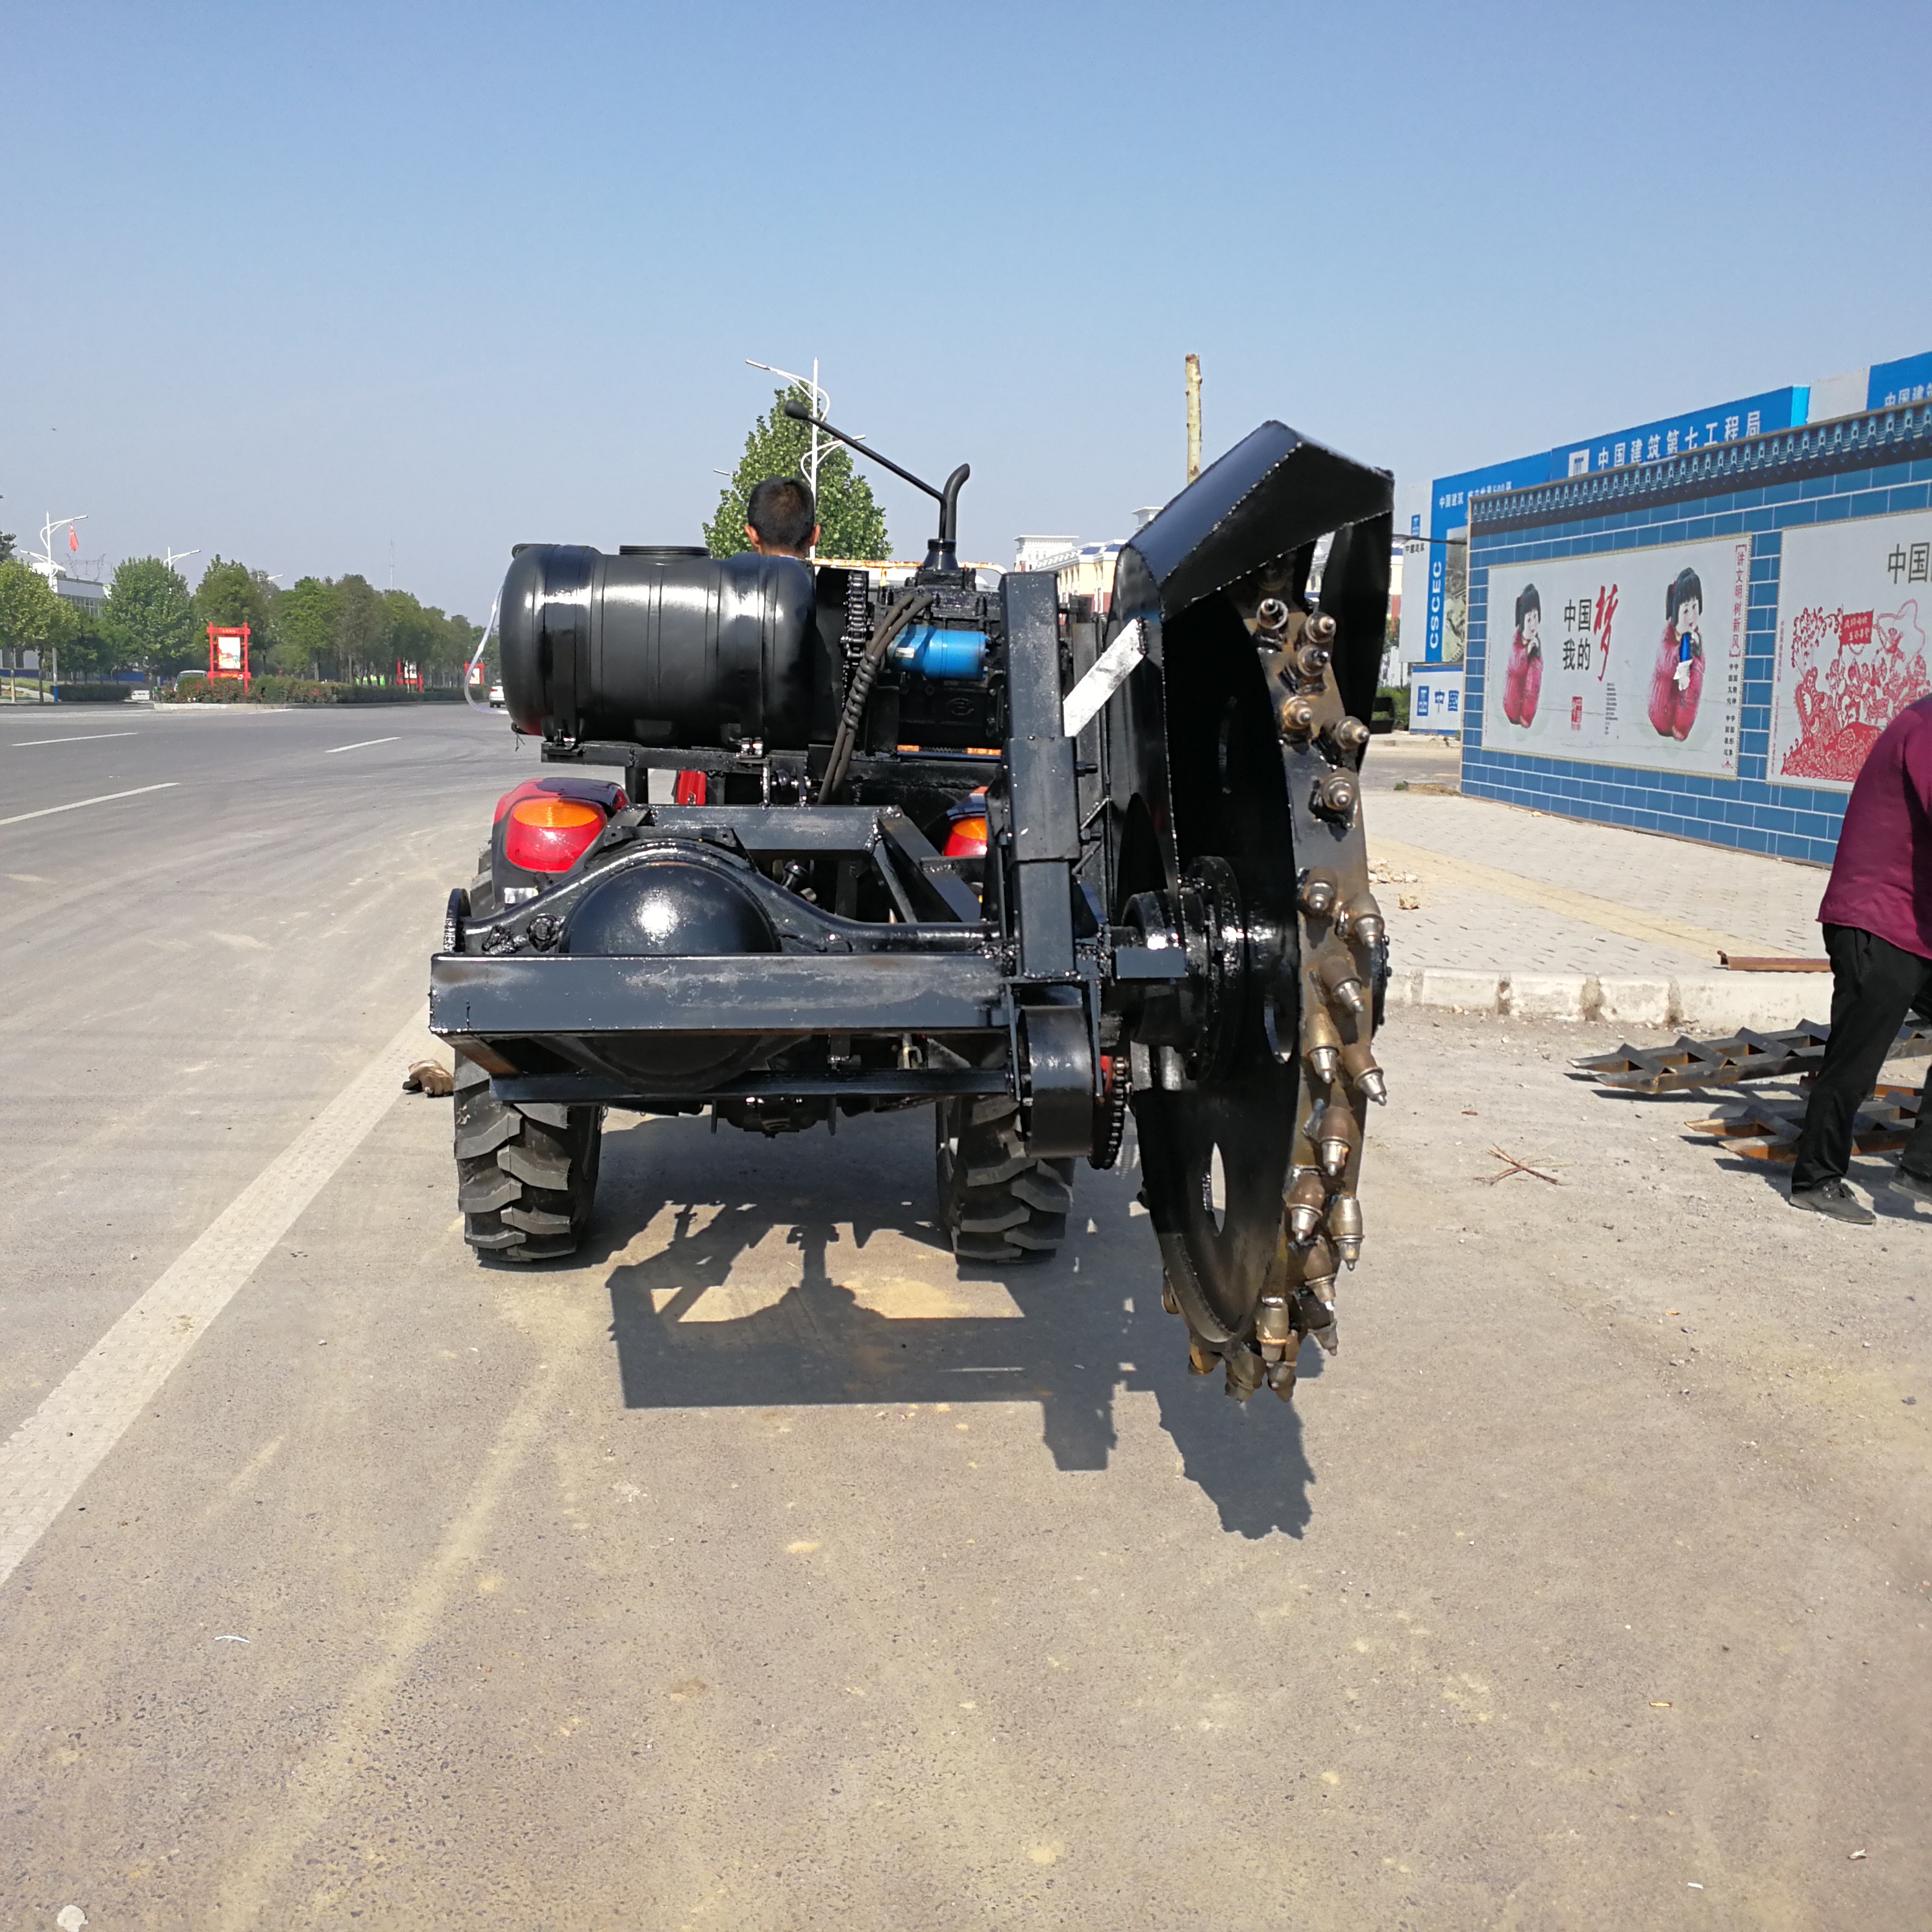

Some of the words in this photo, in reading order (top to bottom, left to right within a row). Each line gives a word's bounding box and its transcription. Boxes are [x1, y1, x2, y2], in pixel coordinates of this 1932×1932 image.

[1598, 410, 1761, 470] 中国建筑第七工程局
[1430, 561, 1443, 649] CSCEC
[1564, 599, 1592, 632] 中国
[1563, 638, 1591, 671] 我的
